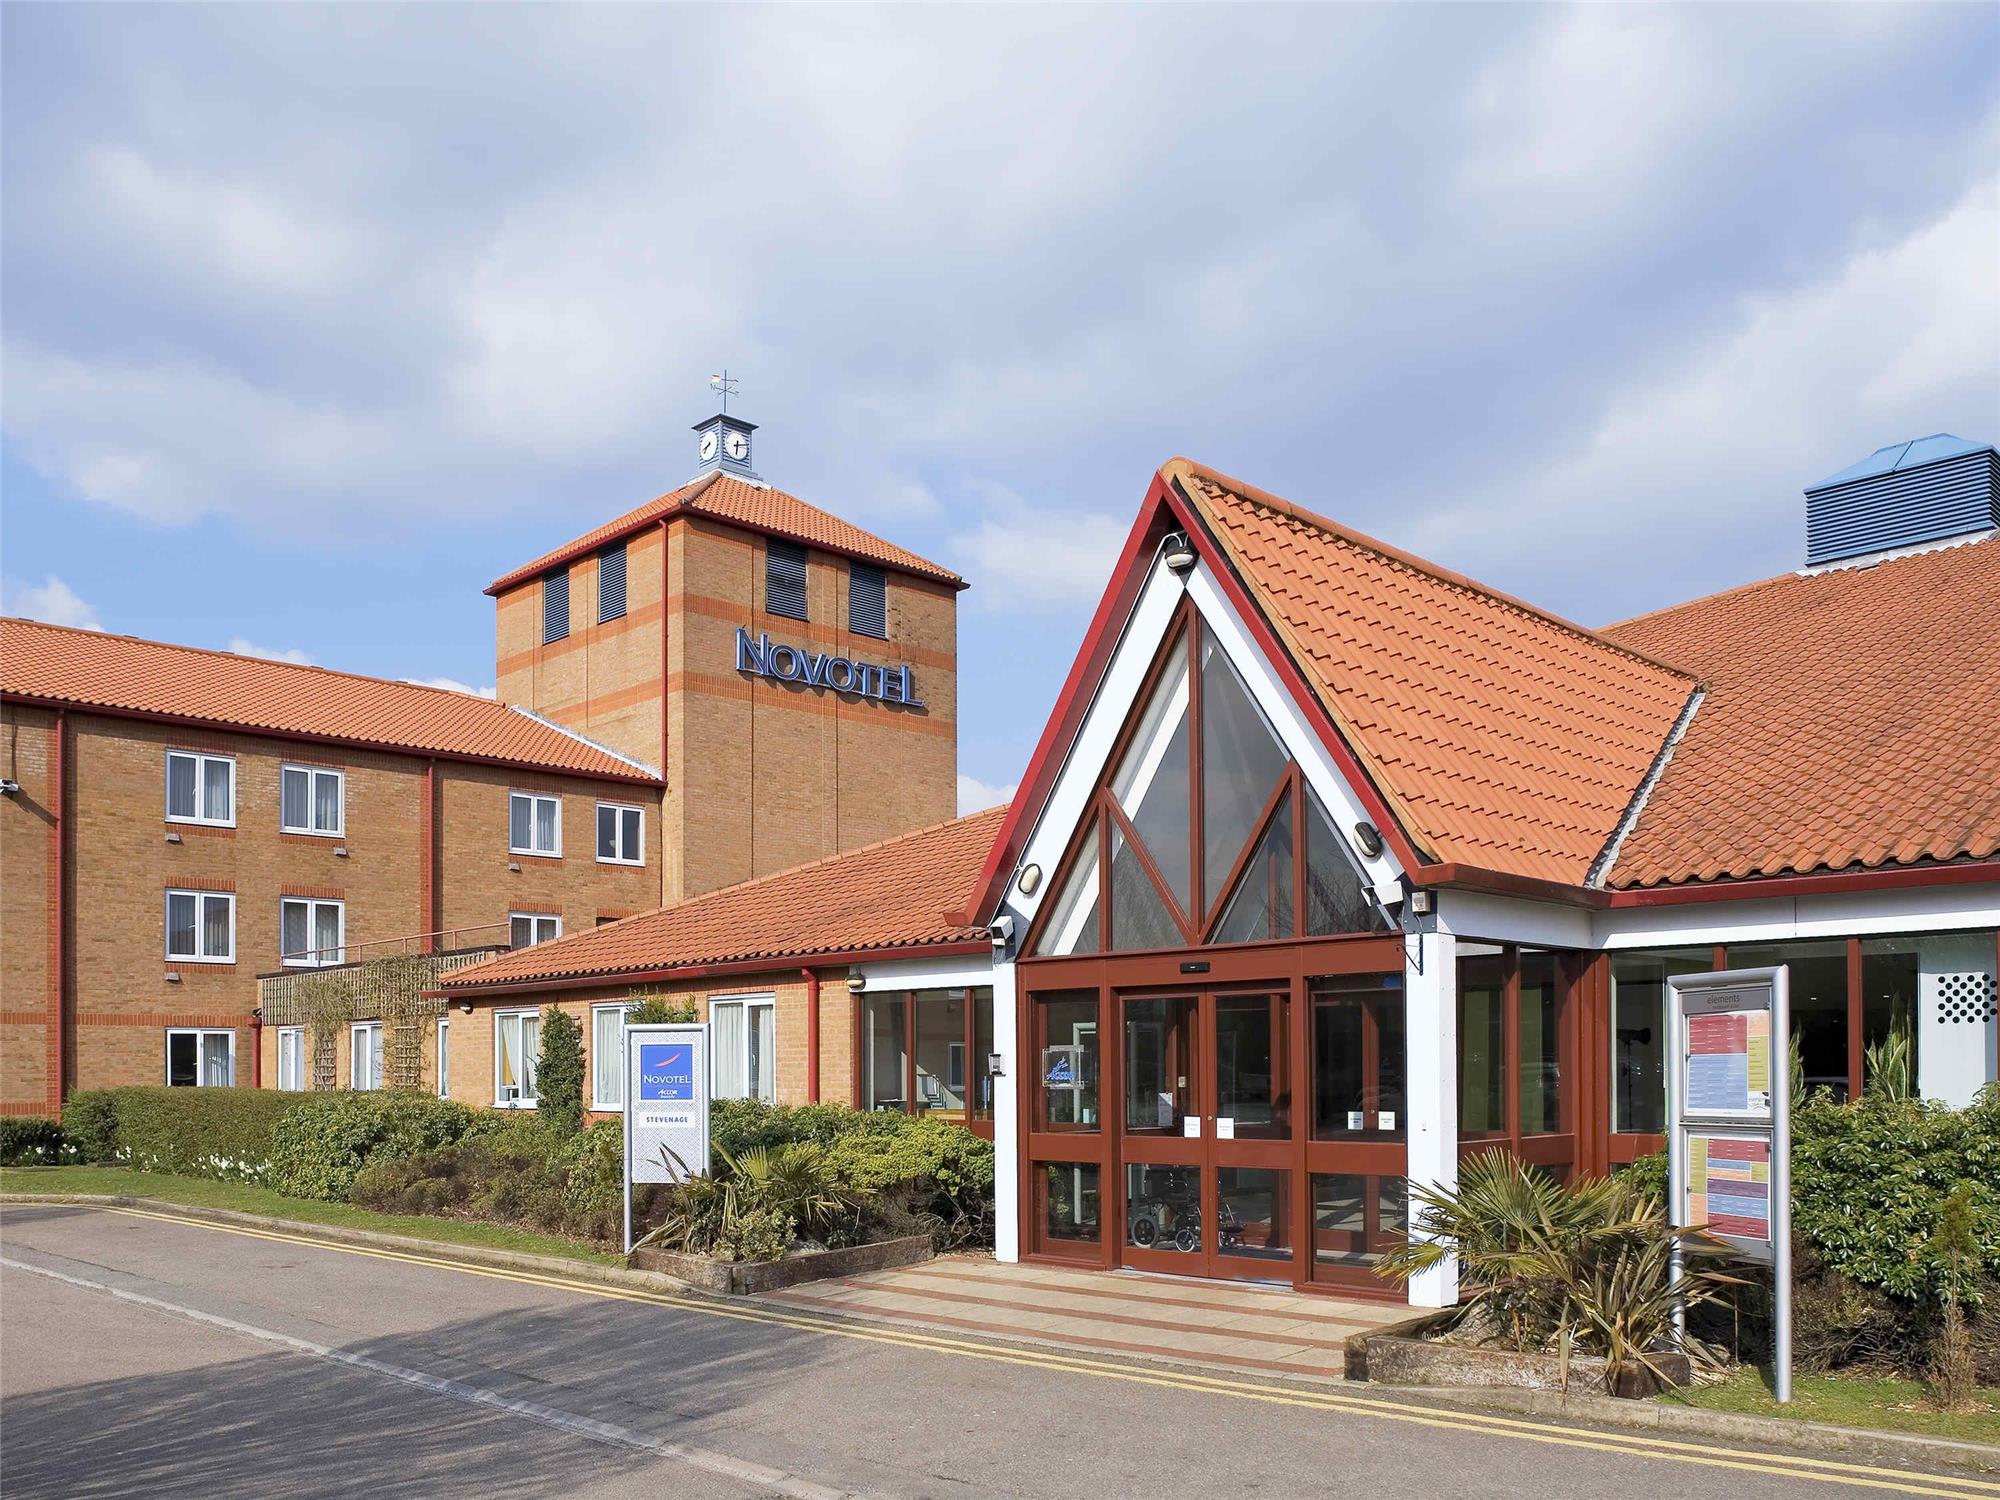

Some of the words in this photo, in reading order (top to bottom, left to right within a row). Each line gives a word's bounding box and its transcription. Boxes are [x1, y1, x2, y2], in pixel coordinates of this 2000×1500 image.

[736, 627, 925, 706] NOVOTEL
[1707, 994, 1740, 1005] elements
[644, 1074, 691, 1084] NOVOTEL
